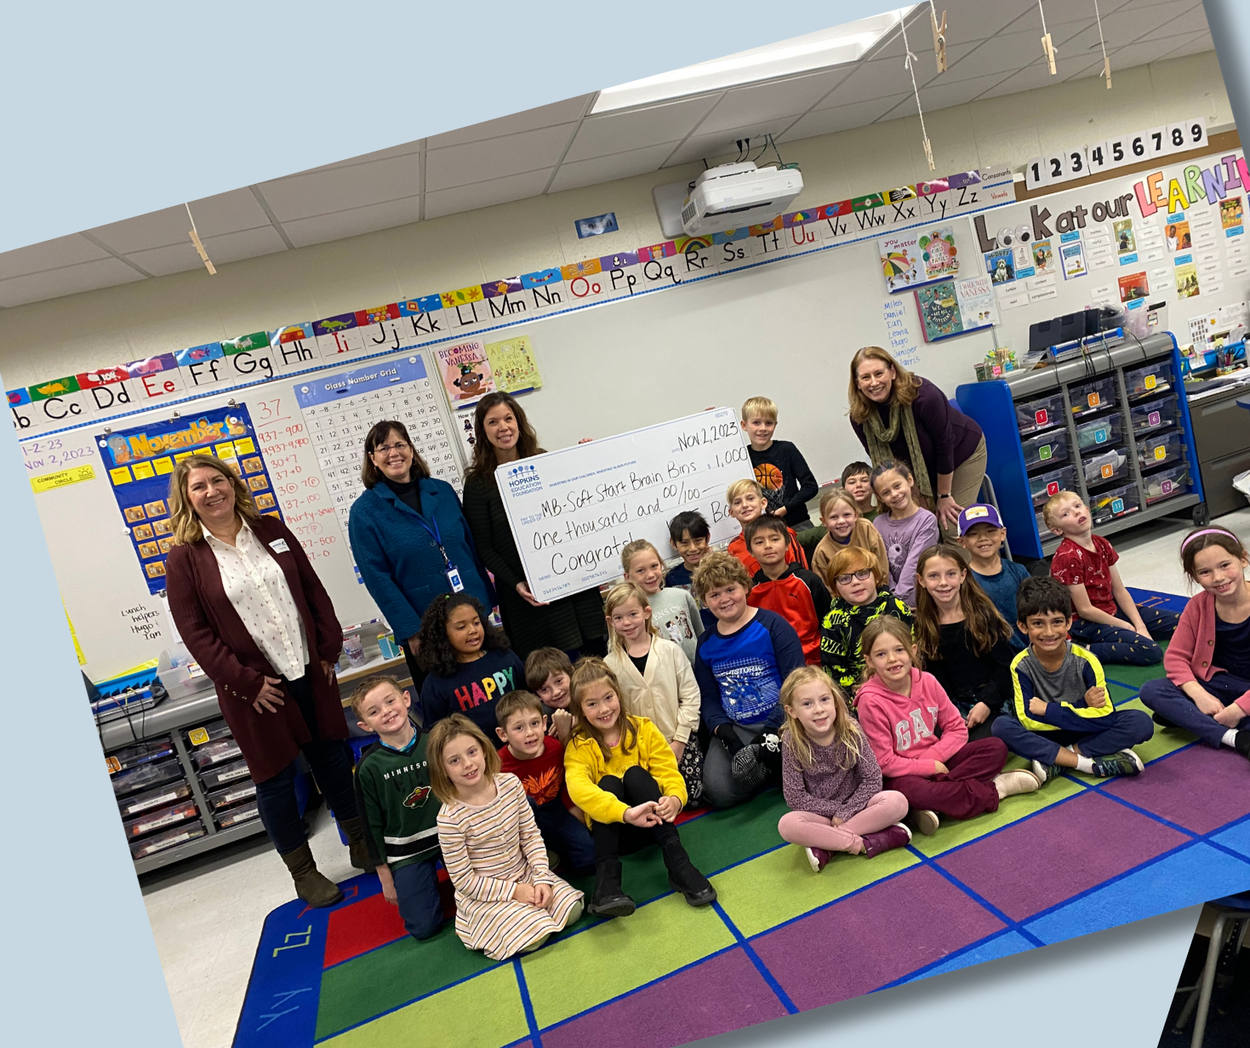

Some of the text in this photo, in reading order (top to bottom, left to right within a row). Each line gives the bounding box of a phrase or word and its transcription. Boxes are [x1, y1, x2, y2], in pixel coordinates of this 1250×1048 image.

[1030, 123, 1203, 182] 1 2 3 4 5 6 7 8 9
[1056, 205, 1087, 234] at
[1092, 192, 1134, 222] our
[439, 342, 479, 359] BECOMING
[445, 353, 479, 367] VANESSA
[325, 367, 397, 391] Class Number Grid
[258, 398, 281, 420] 37
[128, 417, 224, 457] November
[37, 473, 68, 485] COMMUNITY
[508, 475, 540, 488] HOPKINS
[510, 481, 542, 493] EDUCATION
[595, 480, 627, 503] Start
[629, 466, 664, 491] Brain
[666, 461, 697, 481] Bins
[512, 486, 543, 498] FOUNDATION
[565, 498, 662, 540] thousand and
[454, 666, 516, 712] HAPPY
